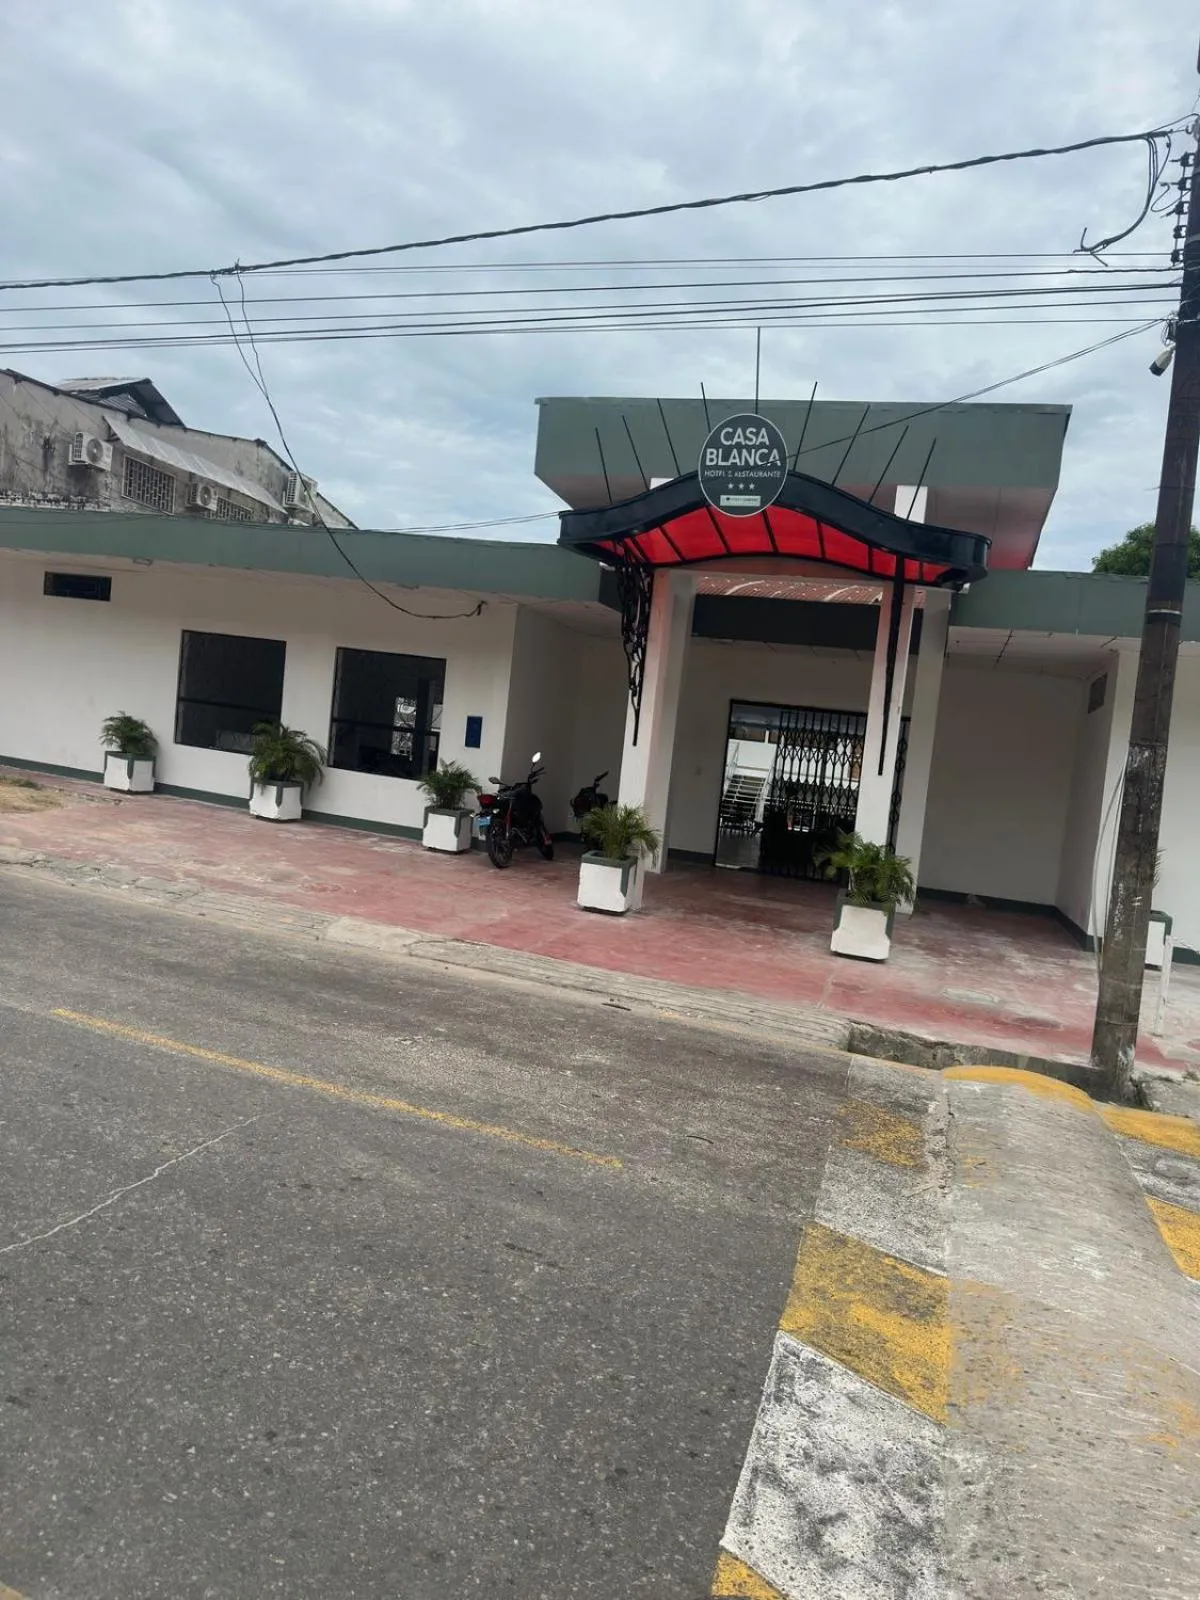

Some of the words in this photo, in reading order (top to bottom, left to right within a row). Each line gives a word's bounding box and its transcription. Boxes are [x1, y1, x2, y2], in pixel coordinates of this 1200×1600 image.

[720, 427, 769, 446] CASA
[705, 448, 781, 466] BLANCA
[734, 470, 781, 478] RESTAURANTE
